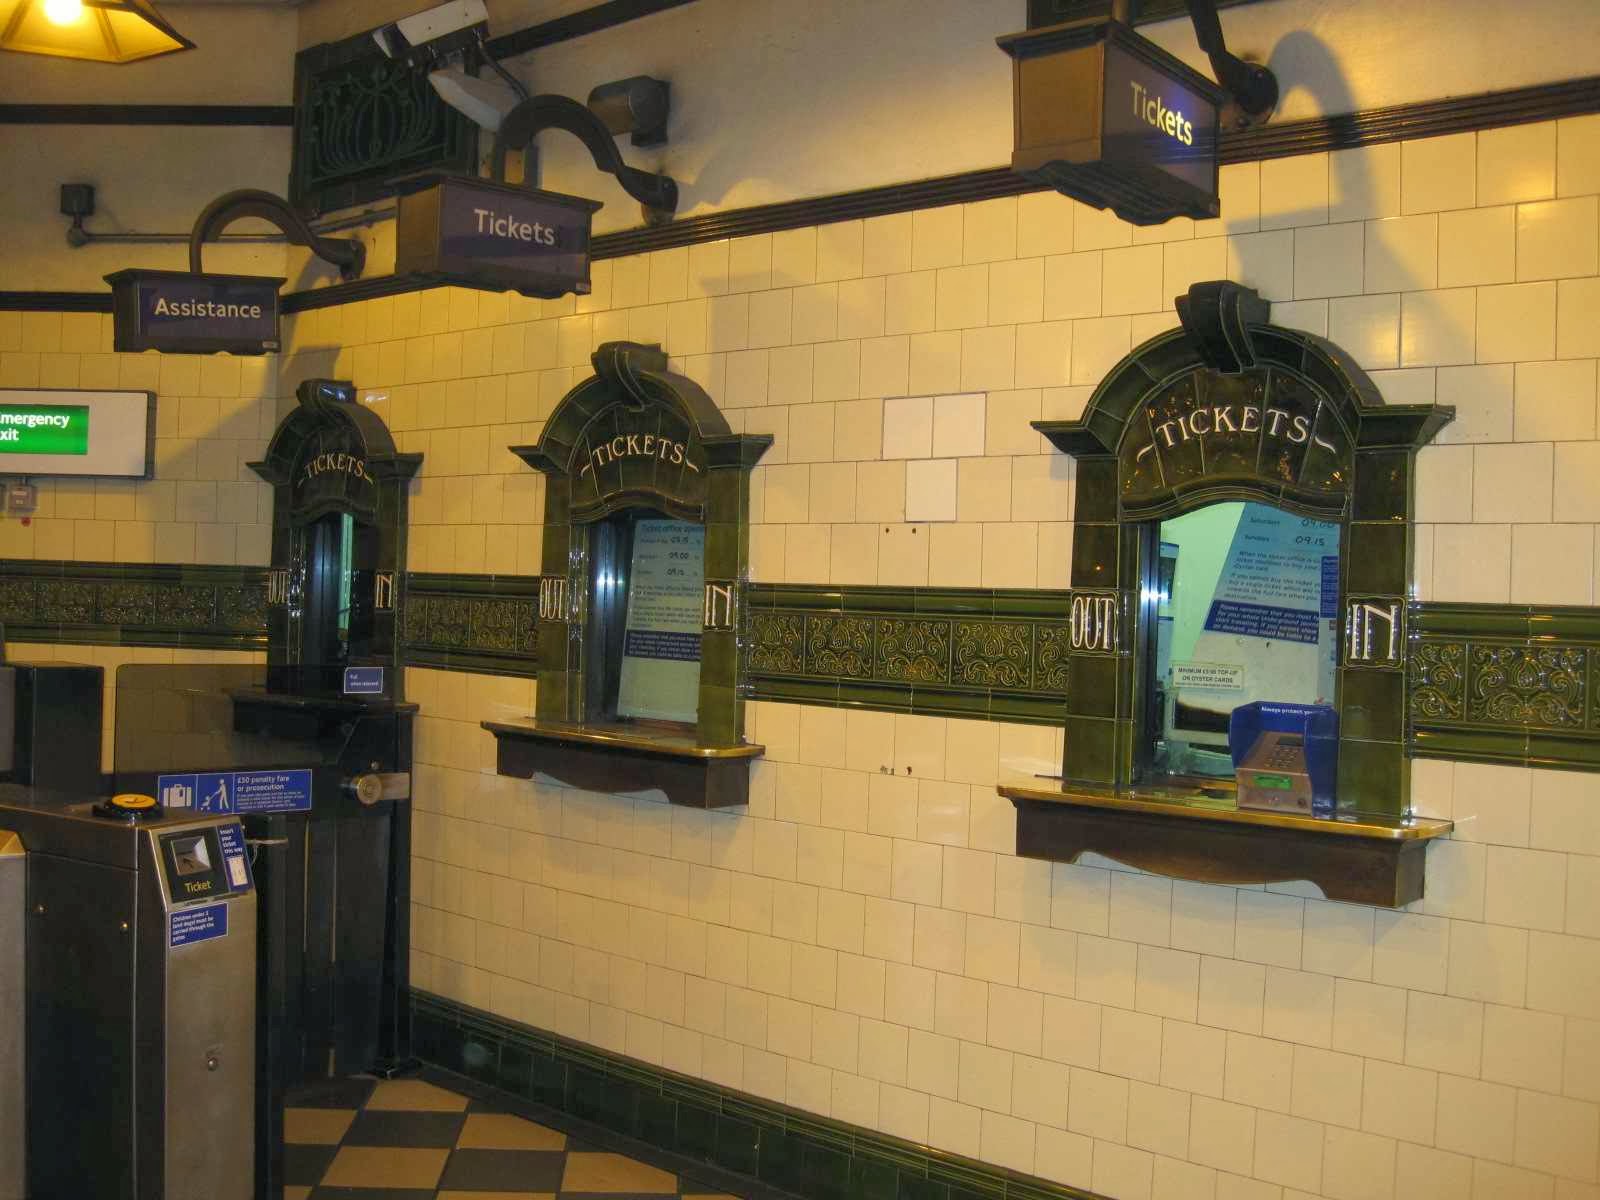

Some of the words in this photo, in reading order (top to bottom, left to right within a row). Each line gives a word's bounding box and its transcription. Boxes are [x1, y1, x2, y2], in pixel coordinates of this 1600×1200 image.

[1131, 80, 1192, 146] Tickets
[474, 208, 555, 246] Tickets
[154, 298, 261, 319] Assistance
[0, 413, 70, 428] mergency
[0, 428, 19, 440] xit
[1156, 405, 1309, 448] TICKETS
[304, 453, 365, 478] TICKETS
[593, 434, 685, 466] TICKETS
[268, 571, 288, 603] OUT
[376, 574, 392, 608] IN
[540, 578, 566, 619] OUT
[705, 585, 733, 626] IN
[1072, 596, 1114, 649] OUT
[1350, 604, 1398, 660] IN
[246, 784, 285, 792] prosecution
[252, 775, 275, 784] penalty
[185, 880, 212, 893] Ticket
